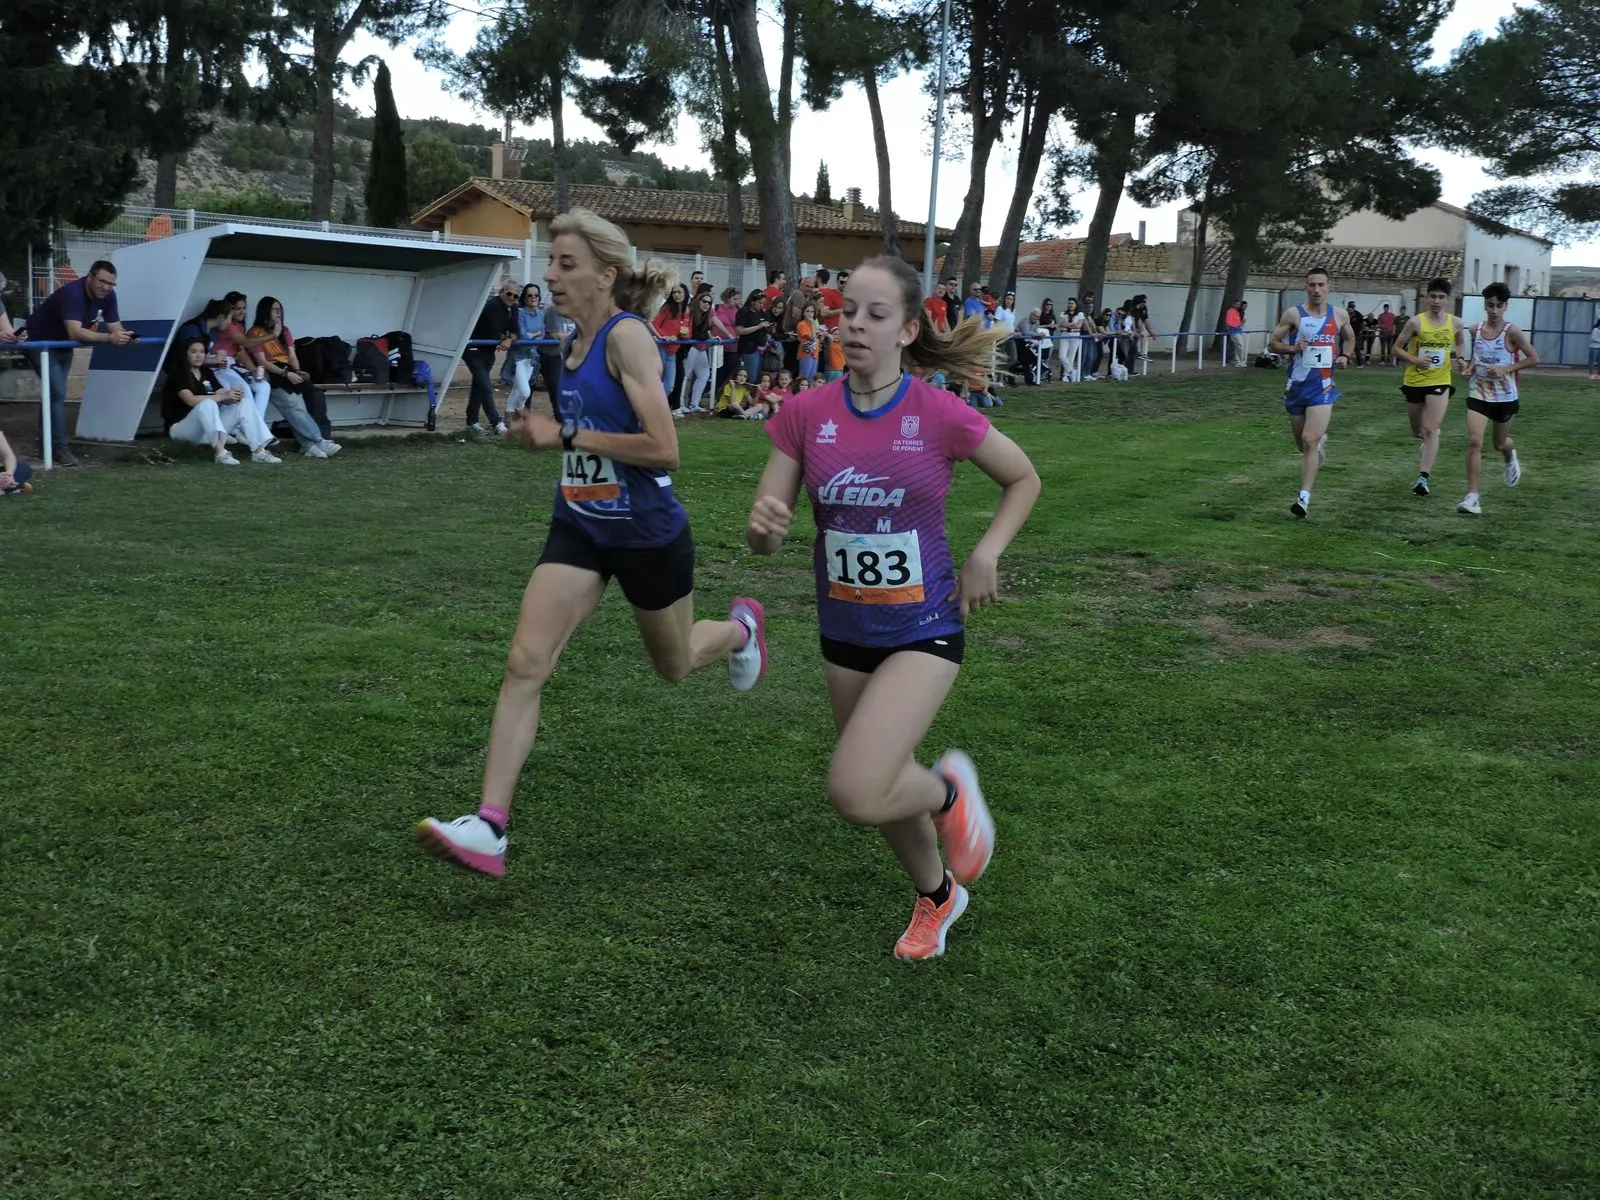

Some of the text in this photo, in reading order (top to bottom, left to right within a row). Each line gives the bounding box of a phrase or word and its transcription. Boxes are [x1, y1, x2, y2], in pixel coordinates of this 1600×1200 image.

[1315, 353, 1322, 363] 1
[901, 445, 924, 453] PONENT
[567, 454, 608, 484] 442
[836, 548, 911, 586] 183
